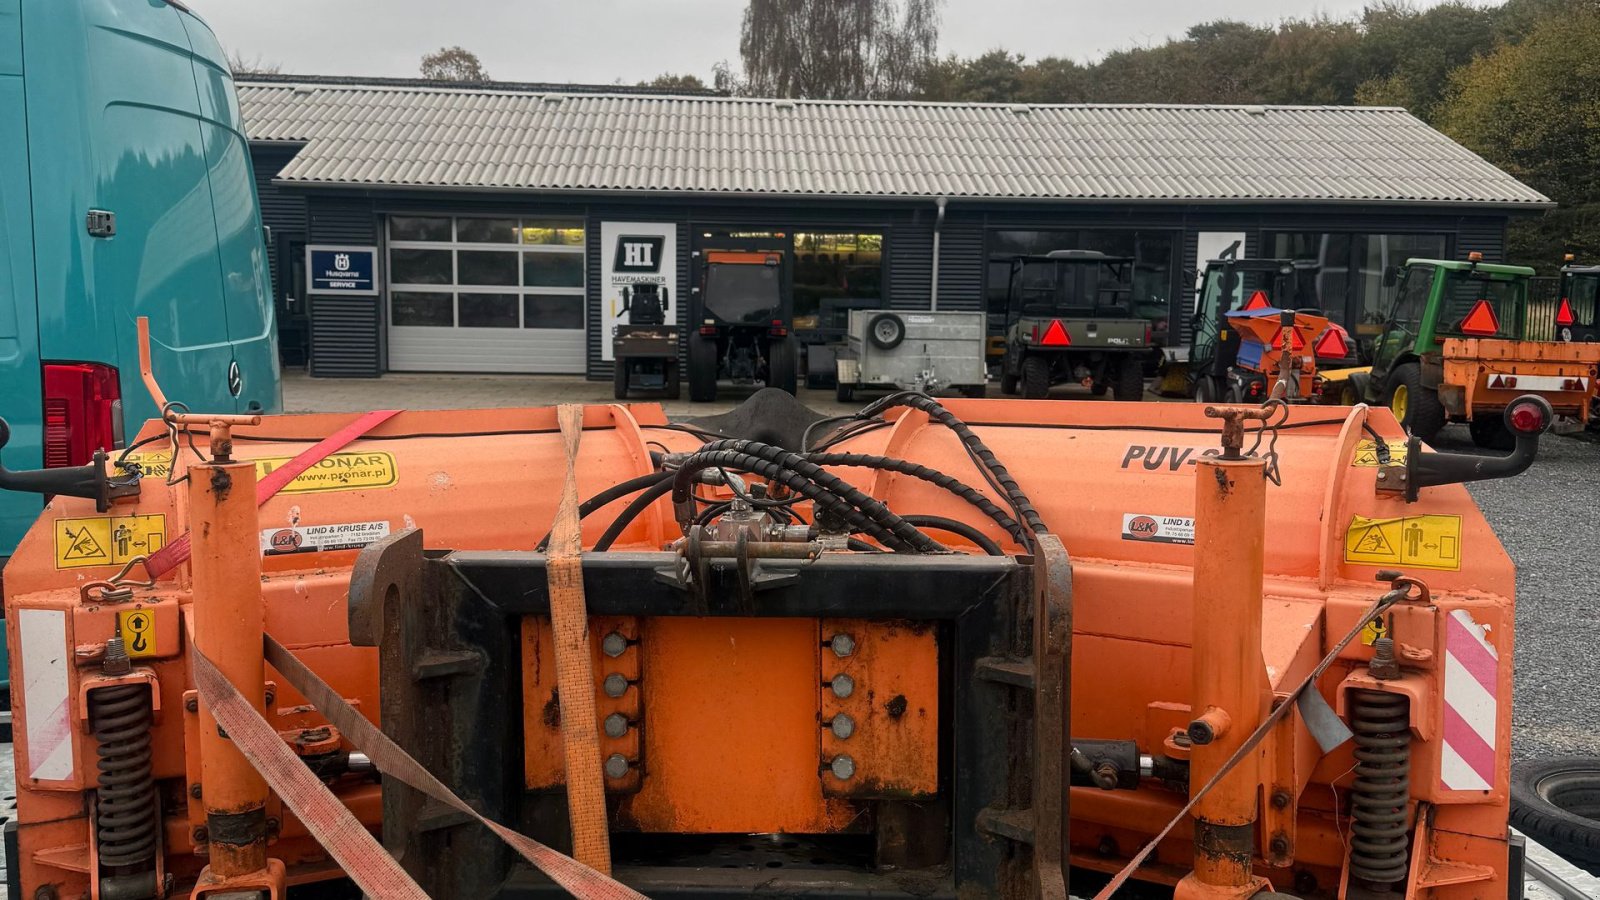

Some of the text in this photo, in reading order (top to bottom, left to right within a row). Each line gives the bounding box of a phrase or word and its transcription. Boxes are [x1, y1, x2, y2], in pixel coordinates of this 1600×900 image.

[624, 243, 653, 266] HI
[296, 468, 386, 482] www.pronar.pl
[1131, 521, 1155, 532] L&K
[1163, 518, 1190, 527] LIND &
[306, 527, 327, 535] LIND
[337, 524, 367, 533] KRUSE
[272, 533, 299, 546] L&K
